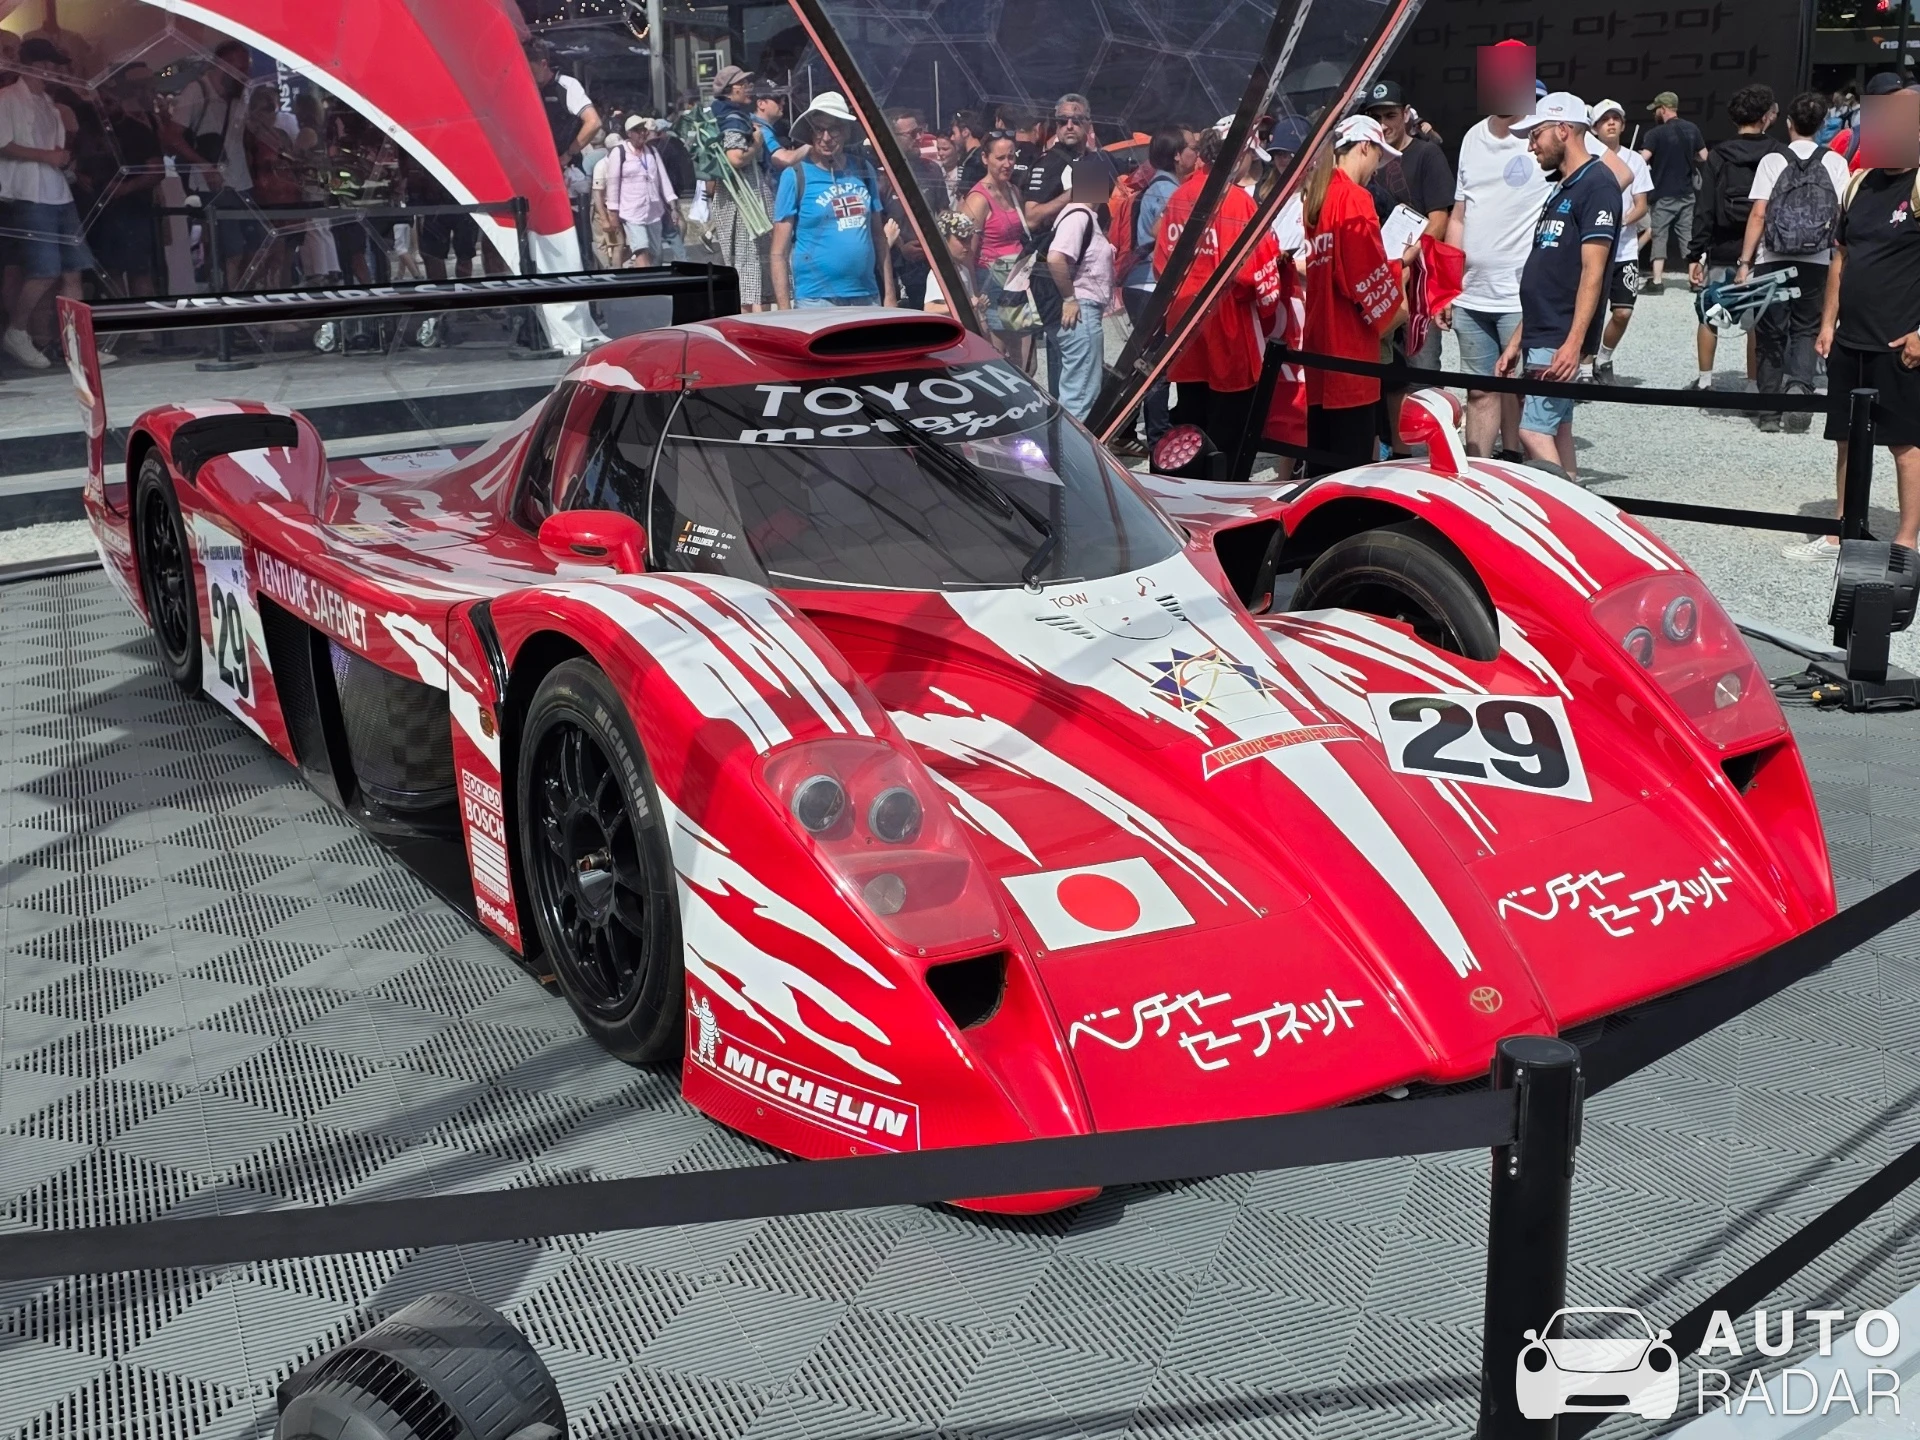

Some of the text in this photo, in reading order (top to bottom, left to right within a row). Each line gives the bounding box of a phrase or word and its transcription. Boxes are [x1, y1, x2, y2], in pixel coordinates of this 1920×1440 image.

[755, 363, 1031, 417] TOYOTA
[254, 547, 367, 651] VENTURE SAFENET
[1050, 593, 1089, 609] TOW
[211, 582, 249, 698] 29
[594, 704, 649, 818] MICHELIN
[1389, 697, 1570, 788] 29
[463, 772, 500, 808] sparco
[464, 796, 506, 844] BOSCH
[476, 895, 515, 936] speedline
[723, 1046, 909, 1137] MICHELIN
